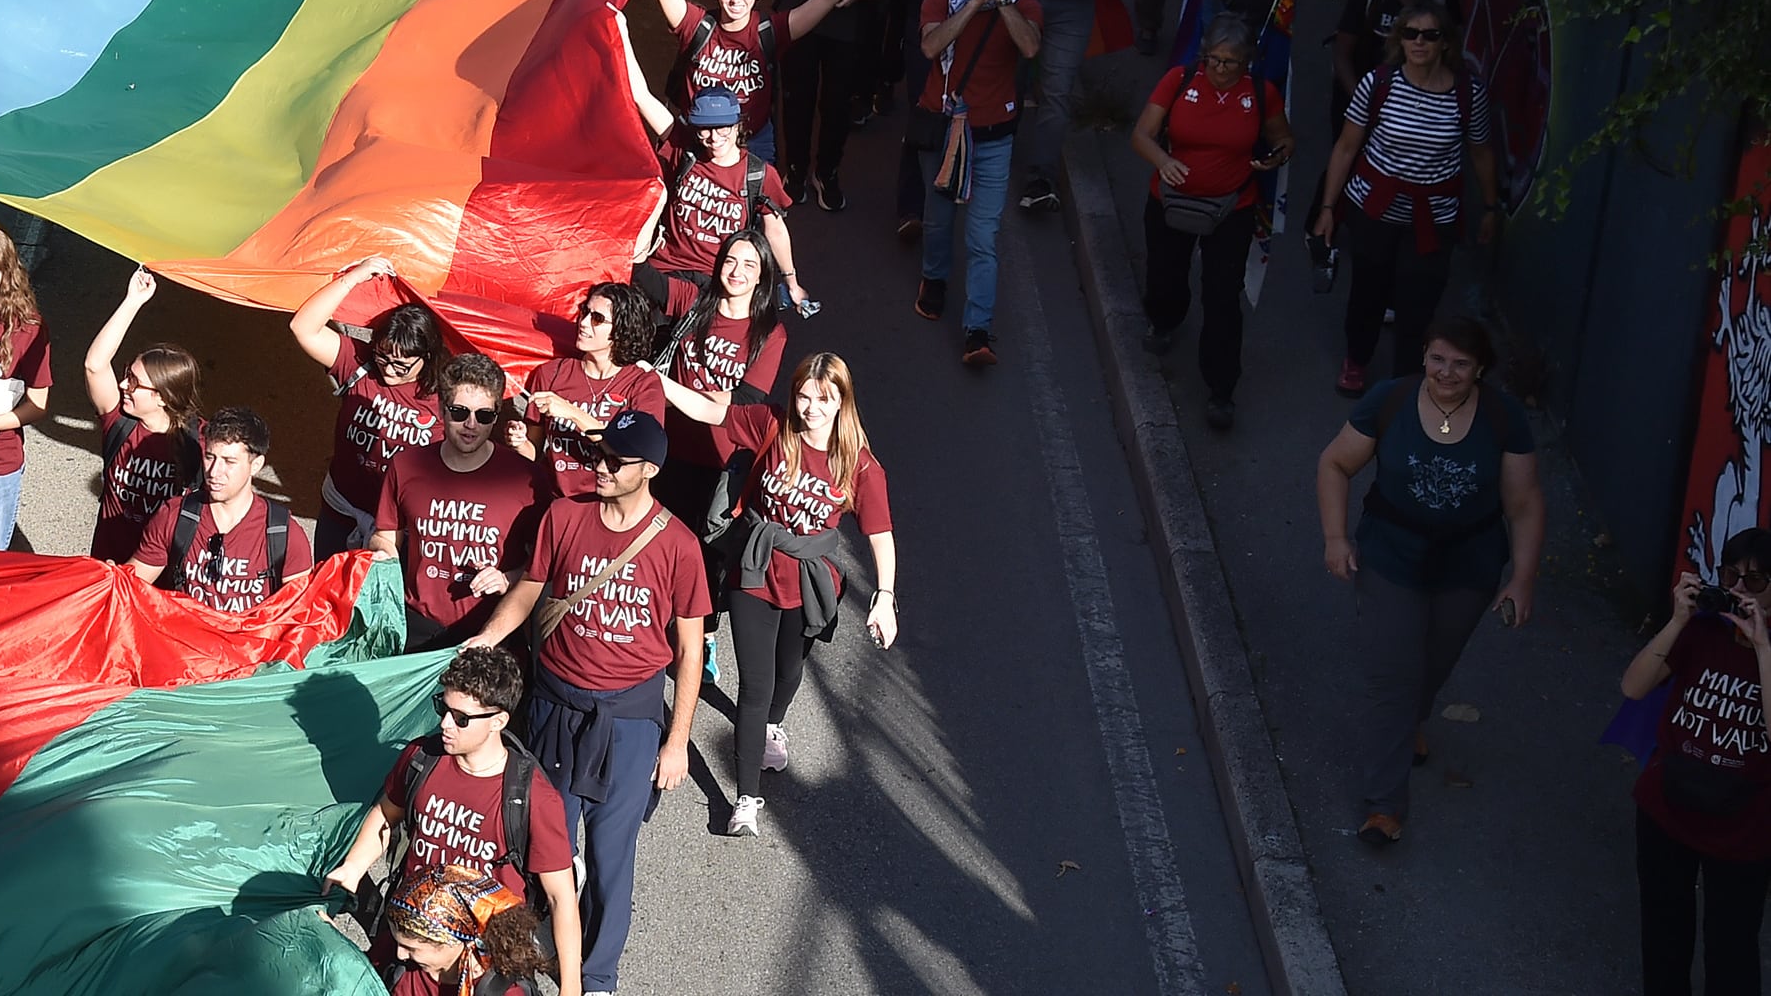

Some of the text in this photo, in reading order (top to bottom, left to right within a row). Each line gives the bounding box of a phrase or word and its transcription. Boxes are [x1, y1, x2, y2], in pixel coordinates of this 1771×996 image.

[693, 70, 721, 88] NOT
[699, 54, 760, 79] HUMMUS
[677, 204, 695, 223] OT
[372, 394, 420, 424] MAKE
[347, 424, 380, 452] NOT
[353, 405, 432, 446] HUMMUS
[429, 498, 486, 521] MAKE
[417, 517, 500, 544] HUMMUS
[198, 549, 249, 577] MKE
[449, 546, 498, 567] WALLS
[600, 603, 652, 631] WALLS
[1699, 668, 1762, 701] MAKE
[1672, 706, 1711, 737] NOT
[1712, 723, 1769, 755] WALLS
[425, 794, 485, 833] MAKE
[418, 813, 498, 861] UMMUS
[415, 839, 440, 864] OT
